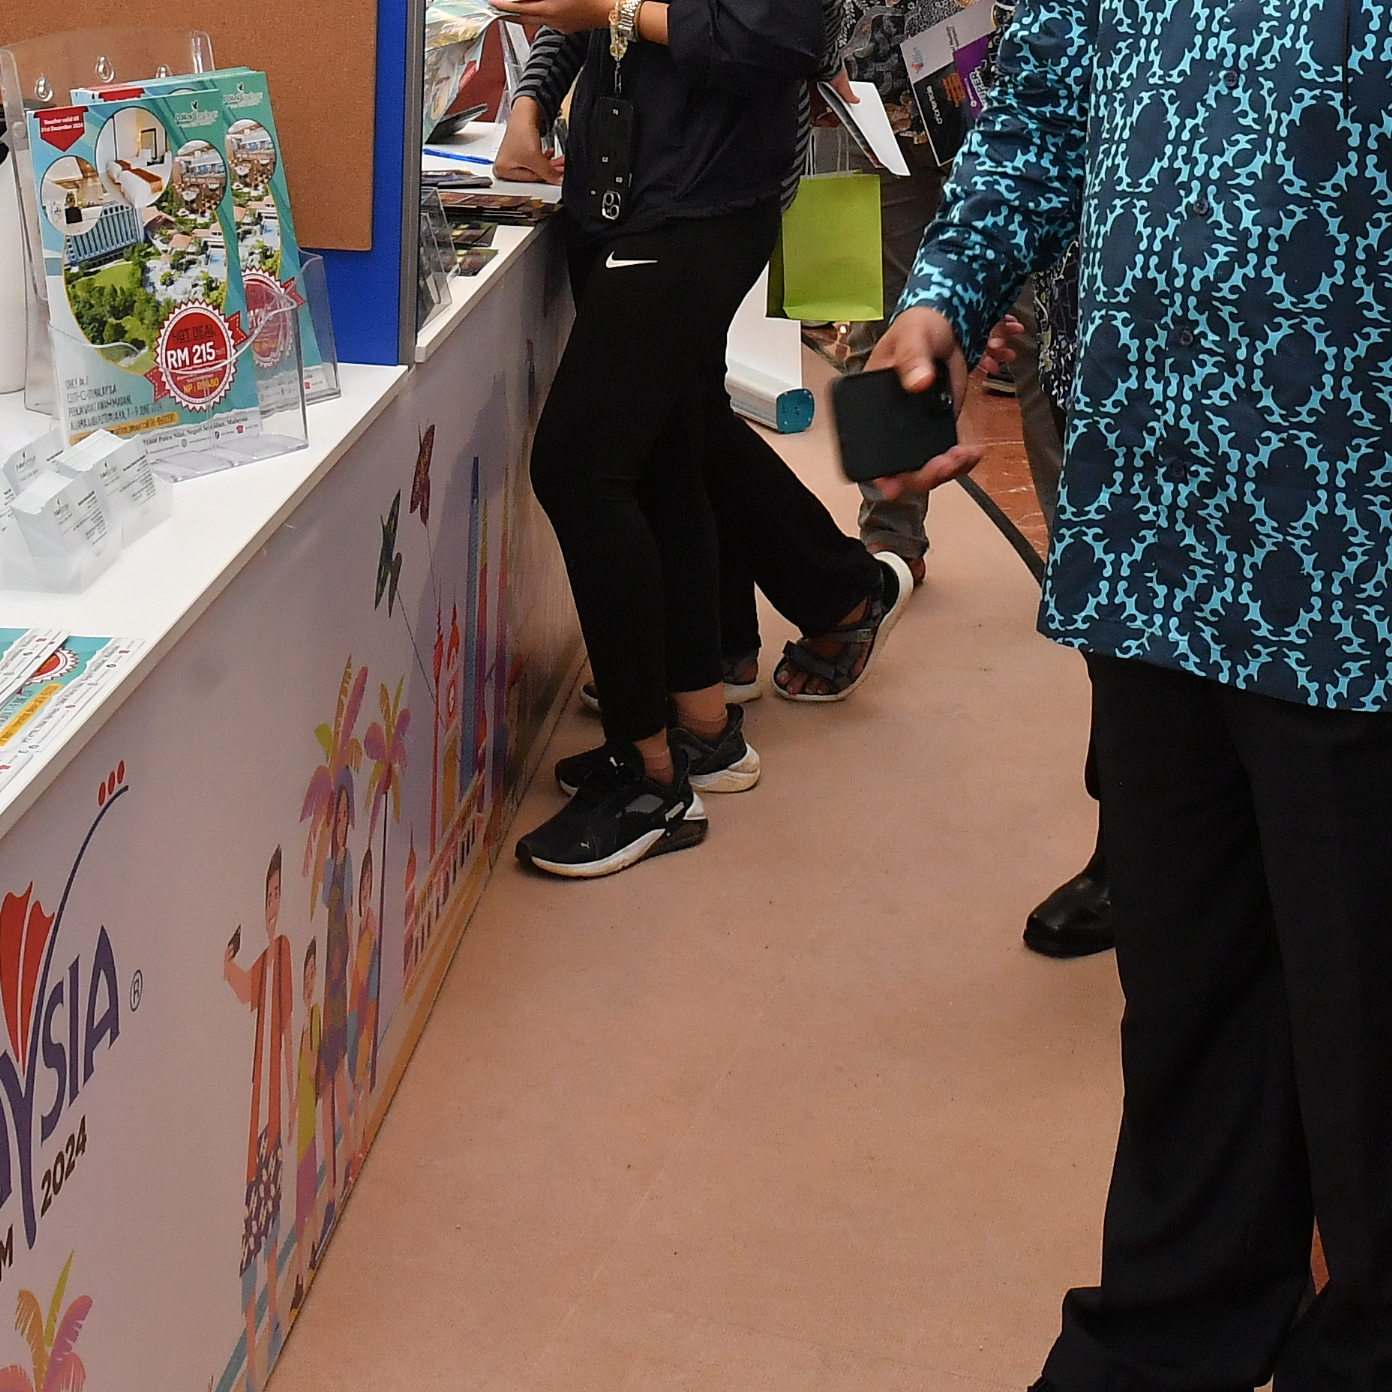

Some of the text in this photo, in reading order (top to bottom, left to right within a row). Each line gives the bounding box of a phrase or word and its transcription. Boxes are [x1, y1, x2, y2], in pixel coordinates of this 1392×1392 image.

[166, 341, 216, 371] RM 215
[40, 1114, 89, 1218] 2024
